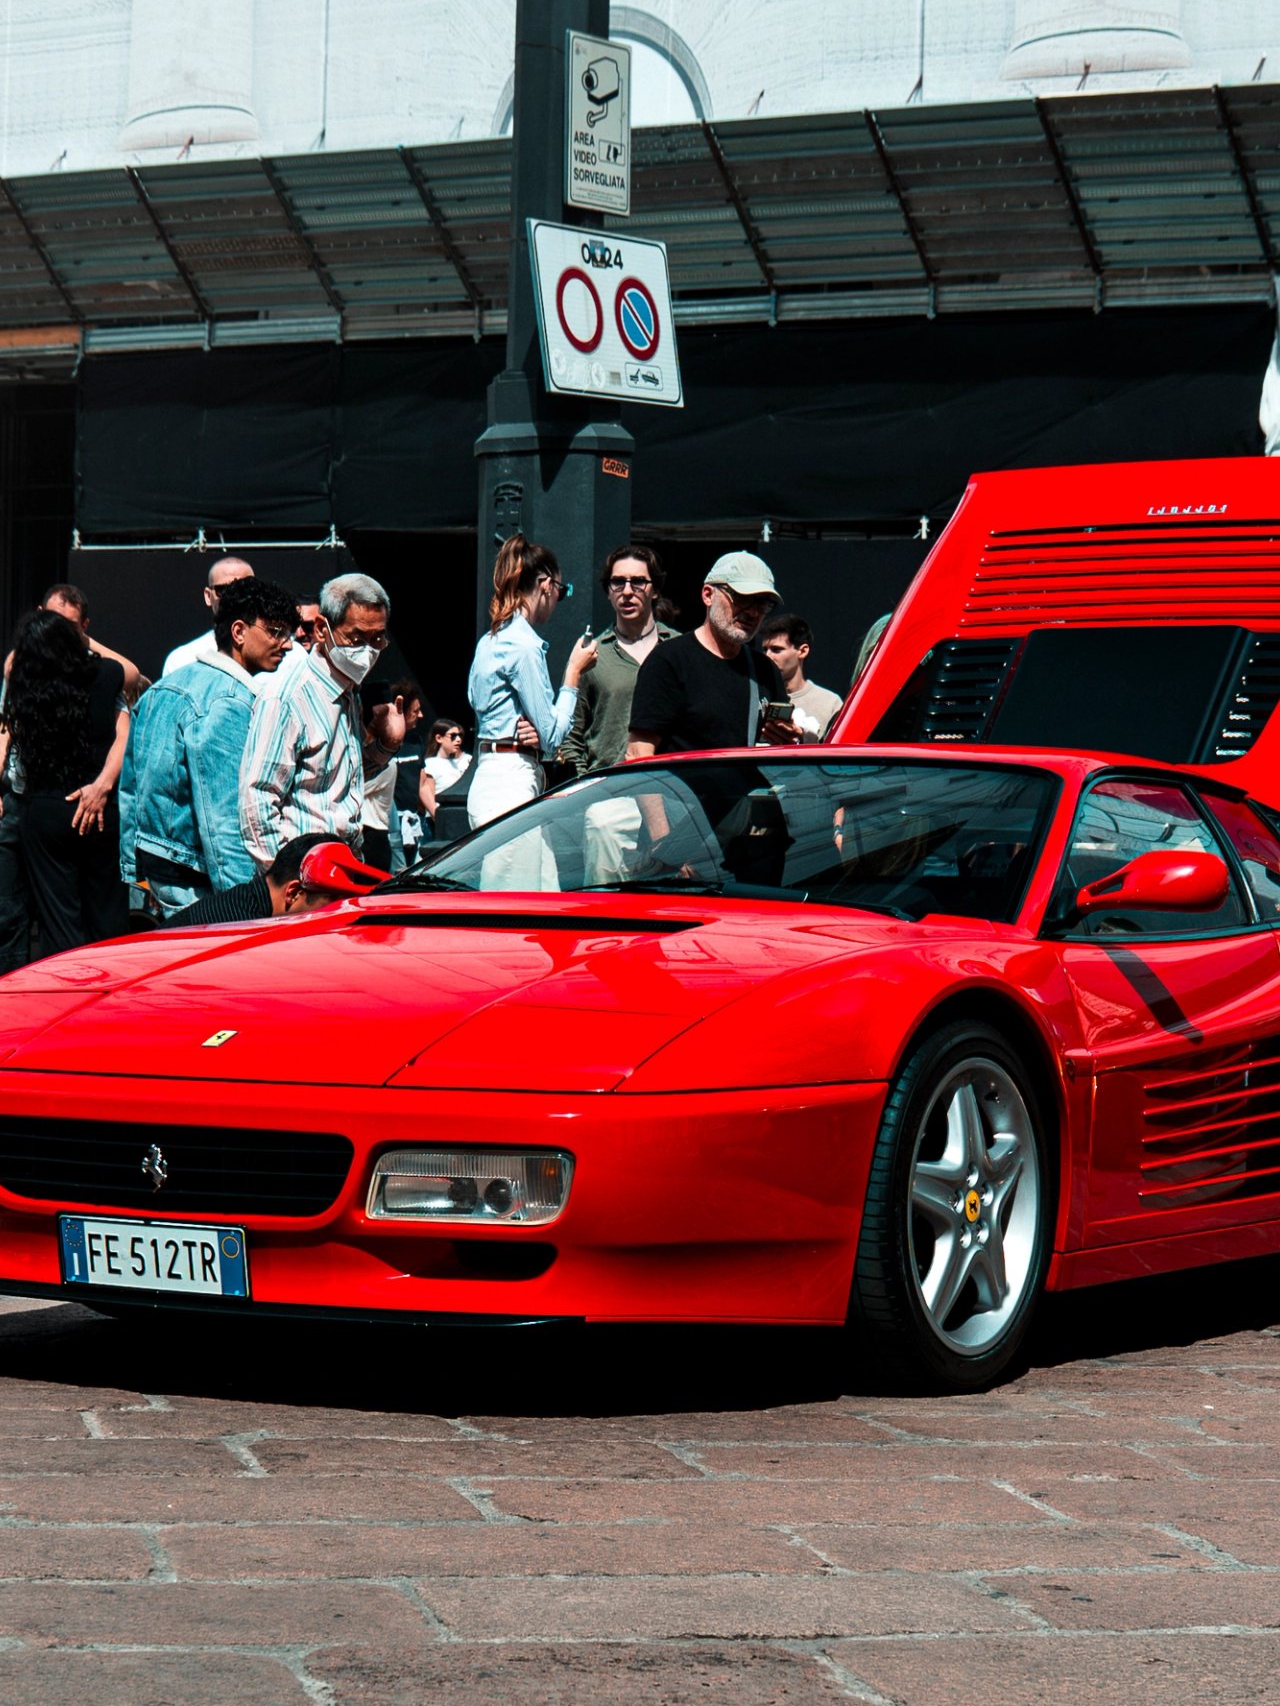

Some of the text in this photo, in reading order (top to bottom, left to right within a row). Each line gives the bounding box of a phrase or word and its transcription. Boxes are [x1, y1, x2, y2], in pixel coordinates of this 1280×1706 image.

[574, 131, 595, 147] AREA
[573, 150, 597, 166] VIDEO
[573, 167, 625, 190] SORVEGLIATA
[581, 242, 624, 270] 024
[87, 1233, 123, 1275] FE
[130, 1236, 218, 1282] 512TR
